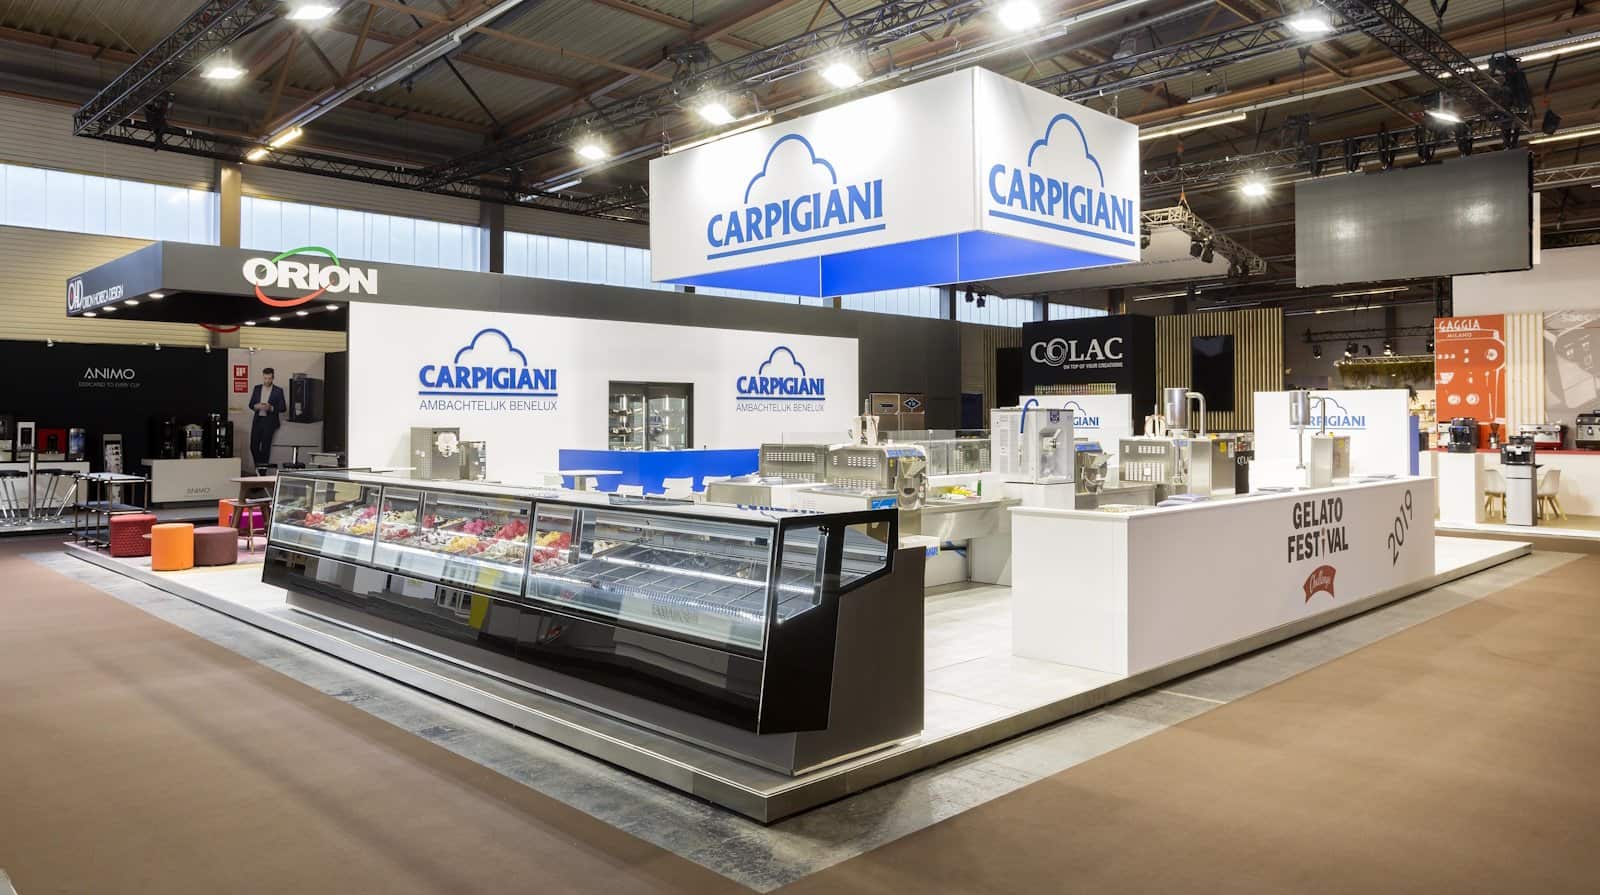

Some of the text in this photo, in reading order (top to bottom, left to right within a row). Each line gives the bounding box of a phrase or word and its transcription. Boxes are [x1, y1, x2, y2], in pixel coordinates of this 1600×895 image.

[988, 163, 1134, 235] CARPIGIANI
[707, 179, 883, 248] CARPIGIANI
[242, 257, 378, 295] ORION
[1439, 319, 1480, 331] GAGGIA
[1030, 337, 1123, 367] COLAC
[84, 367, 136, 380] ANIMO
[419, 365, 557, 390] CARPIGIANI
[736, 376, 825, 395] CARPIGIANI
[419, 400, 557, 411] AMBACHTELIJK BENELUX
[736, 403, 825, 412] AMBACHTELIJK BENELUX
[1073, 416, 1099, 426] GIANI
[1310, 415, 1366, 427] RPIGIANI
[1293, 496, 1343, 529] GELATO
[1387, 489, 1413, 569] 2019
